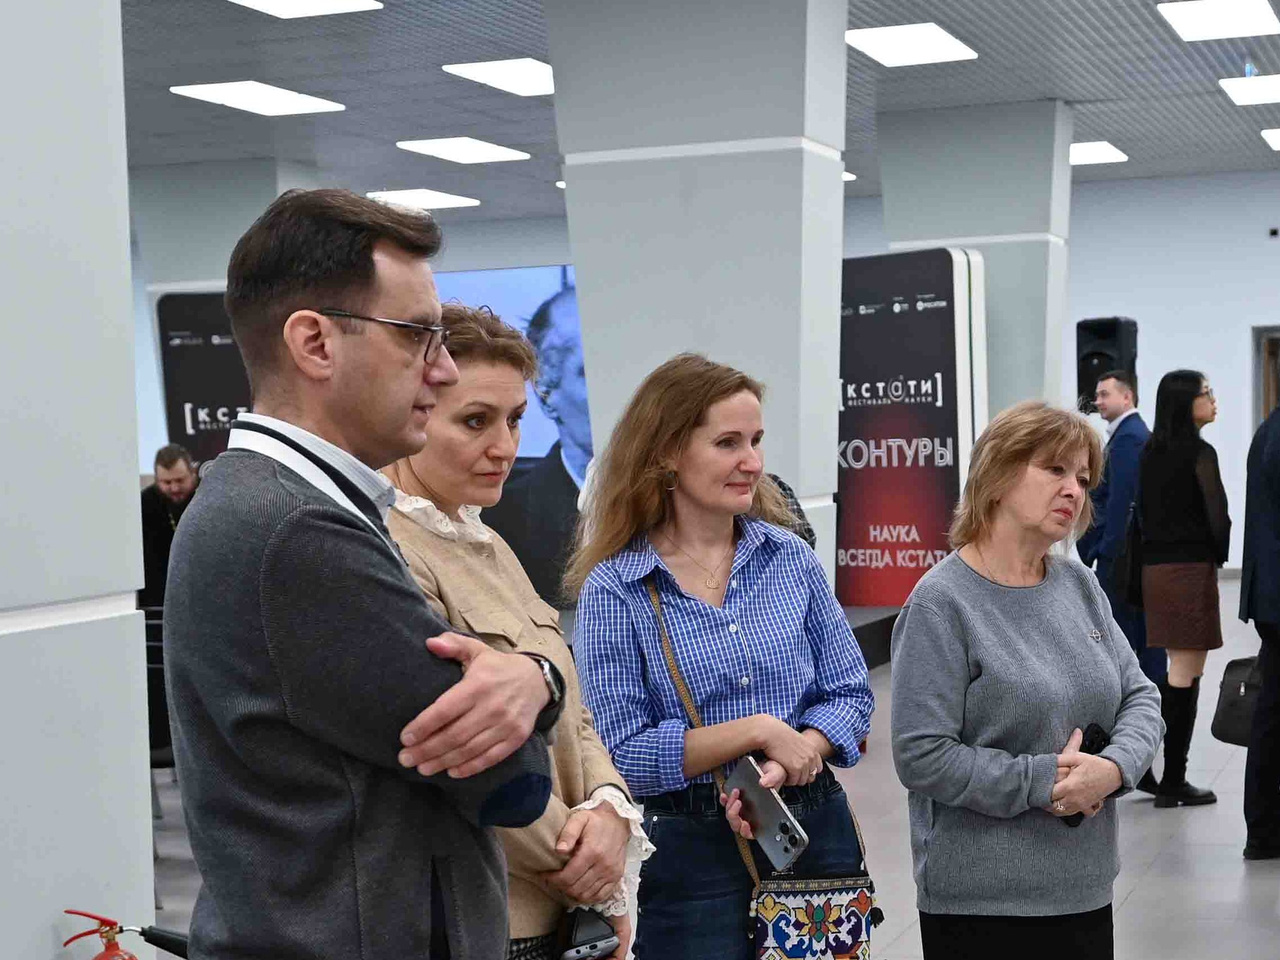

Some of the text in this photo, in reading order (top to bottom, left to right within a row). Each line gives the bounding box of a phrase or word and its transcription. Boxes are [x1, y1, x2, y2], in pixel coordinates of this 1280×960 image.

[838, 437, 953, 469] КОНТУРЫ
[869, 525, 921, 542] НАУКА
[837, 548, 893, 569] ВСЕГДА
